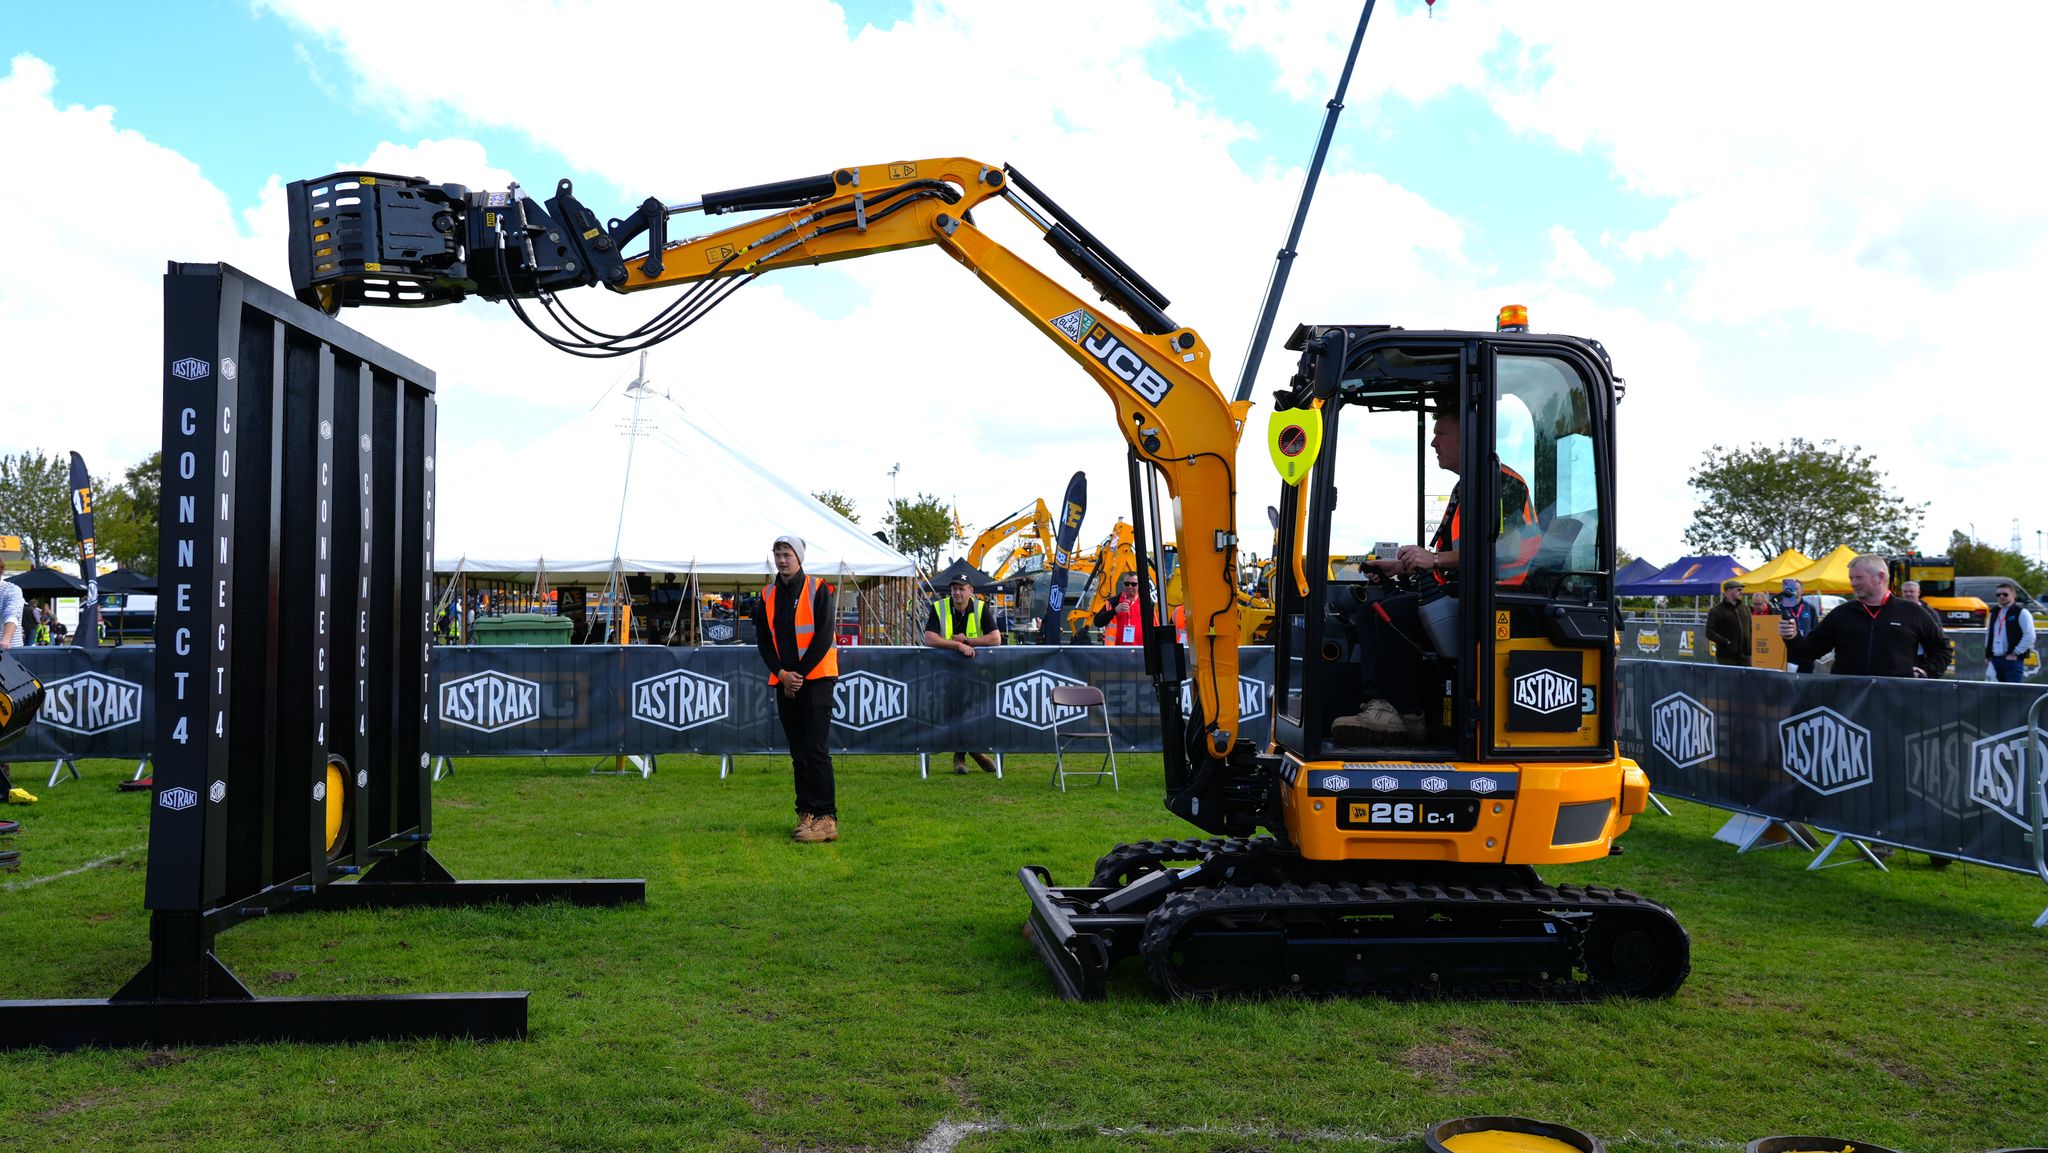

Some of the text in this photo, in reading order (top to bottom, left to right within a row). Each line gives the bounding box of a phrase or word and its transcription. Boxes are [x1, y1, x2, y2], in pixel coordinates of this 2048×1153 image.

[1068, 315, 1079, 325] 37
[174, 359, 208, 379] ASTRAK
[1085, 336, 1168, 403] JCB
[172, 407, 196, 745] CONNECT 4
[215, 406, 231, 738] CONNECT 4
[317, 462, 328, 746] CONNECT 4
[1947, 611, 1971, 619] JCB
[42, 677, 136, 729] ASTRAK
[445, 676, 534, 726] ASTRAK
[638, 675, 723, 725] ASTRAK
[832, 676, 902, 725] STRAK
[1517, 672, 1573, 710] ASTRAK
[359, 714, 365, 737] 4
[1655, 699, 1711, 761] ASTRAK
[1786, 714, 1866, 787] ASTRAK
[161, 788, 195, 809] ASTRAK
[1324, 776, 1348, 791] ASTRAK
[1373, 776, 1398, 792] ASTRAK
[1422, 777, 1447, 792] ASTRAK
[1471, 777, 1496, 793] ASTRAK
[1371, 803, 1414, 824] 26
[1427, 813, 1455, 824] C-1
